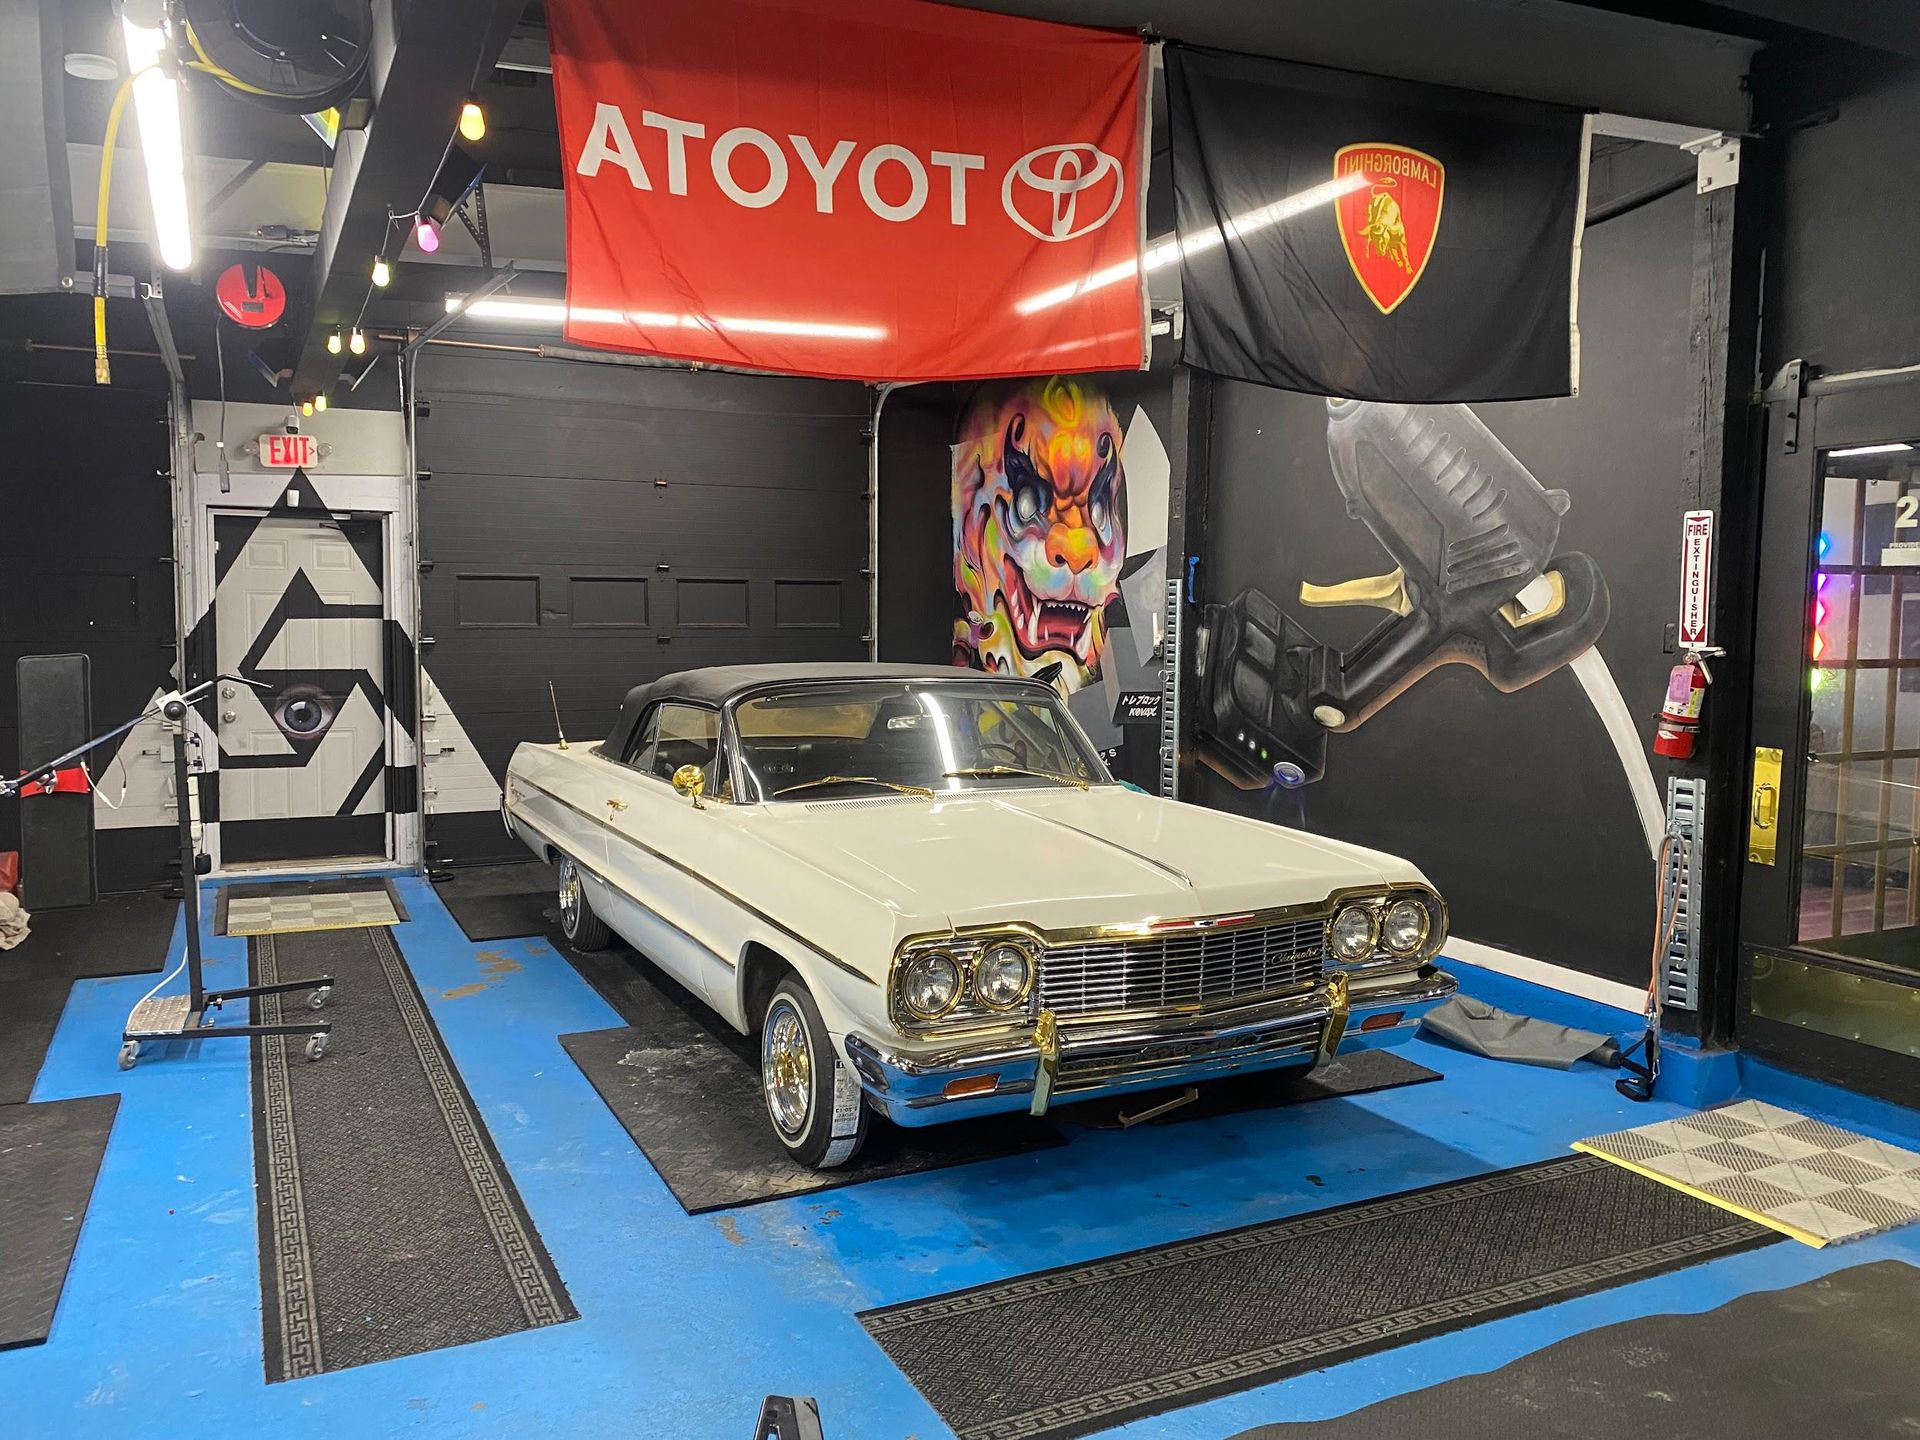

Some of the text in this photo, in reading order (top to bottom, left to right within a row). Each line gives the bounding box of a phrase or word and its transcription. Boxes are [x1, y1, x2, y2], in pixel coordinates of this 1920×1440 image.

[269, 437, 309, 464] EXIT
[1894, 495, 1919, 528] 2
[1687, 524, 1708, 536] FIRE
[1690, 538, 1701, 636] EXTINGUISHER
